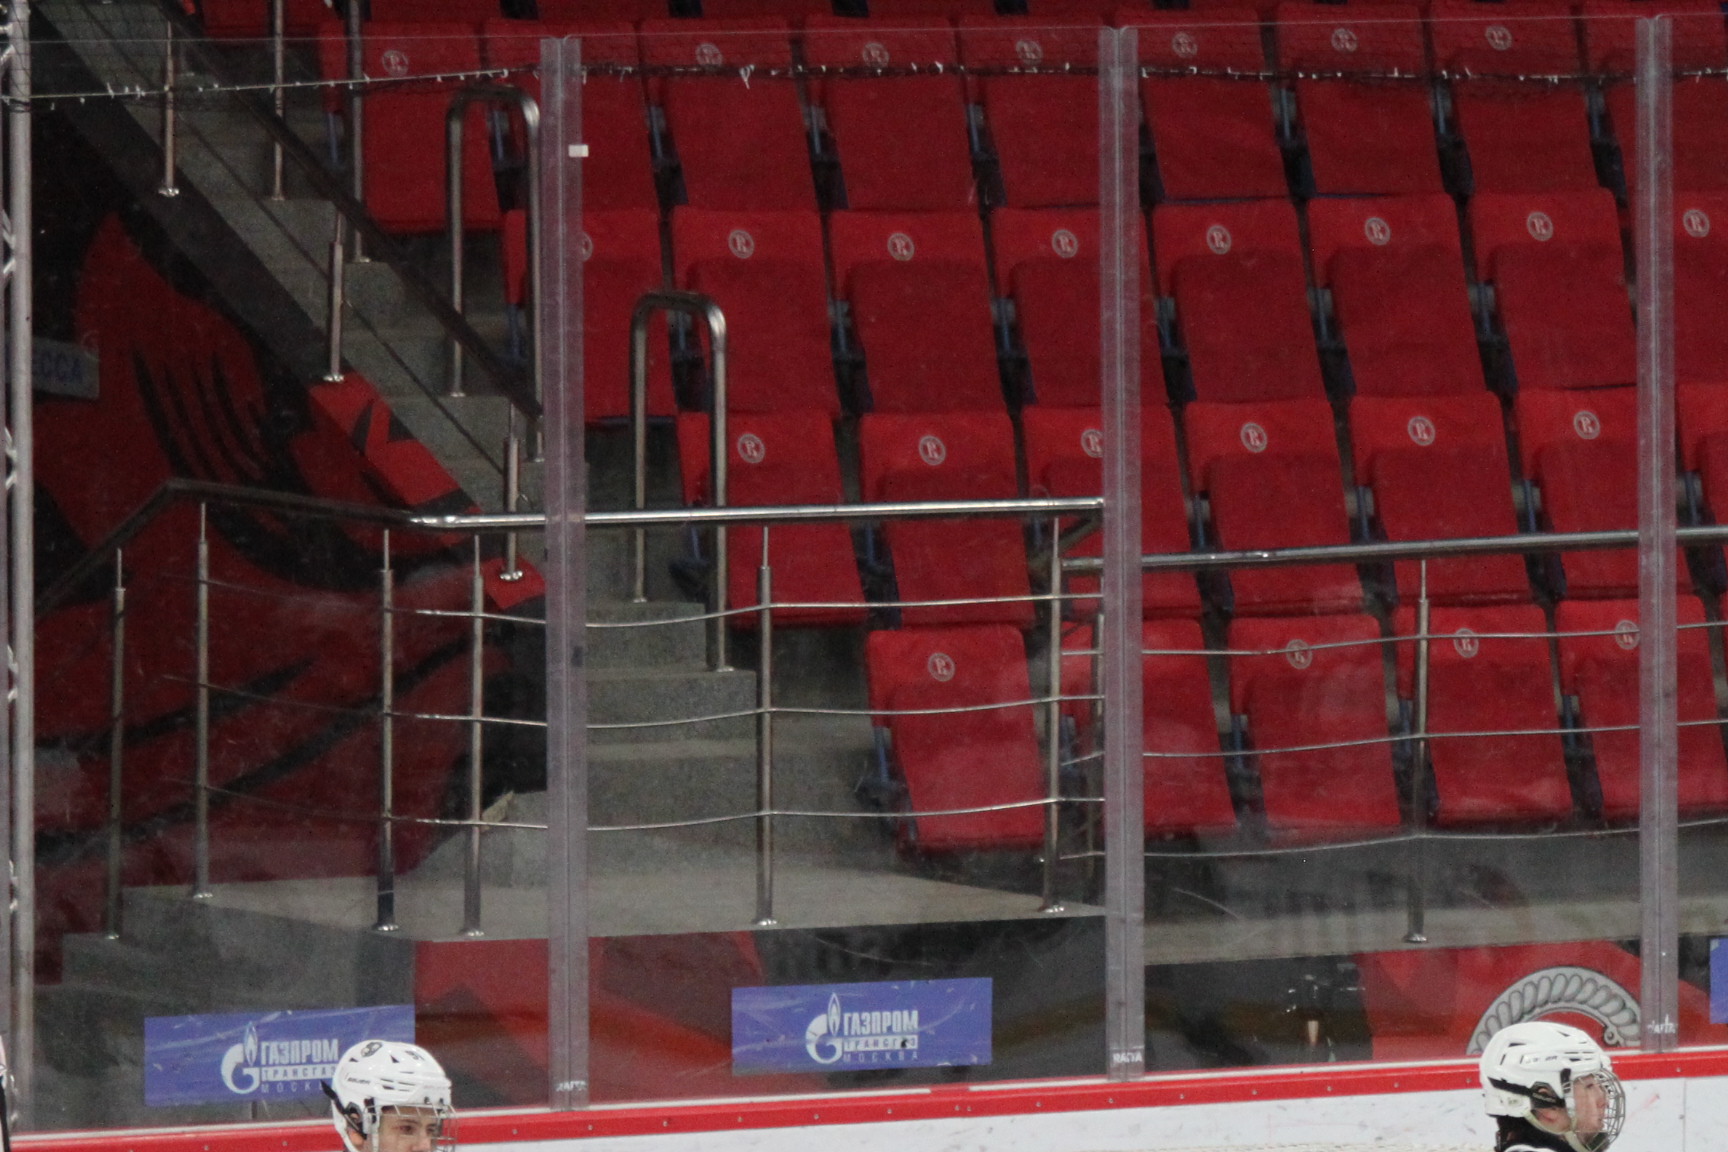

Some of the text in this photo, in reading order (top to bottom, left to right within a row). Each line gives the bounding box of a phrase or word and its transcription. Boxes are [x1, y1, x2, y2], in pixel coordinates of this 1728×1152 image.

[844, 1010, 919, 1036] ГАЗПРОМ
[844, 1036, 918, 1050] ТРАНСГЗ
[261, 1039, 339, 1065] ГАЗПРОМ
[843, 1050, 918, 1063] МОСКВА
[261, 1081, 322, 1094] МОСК
